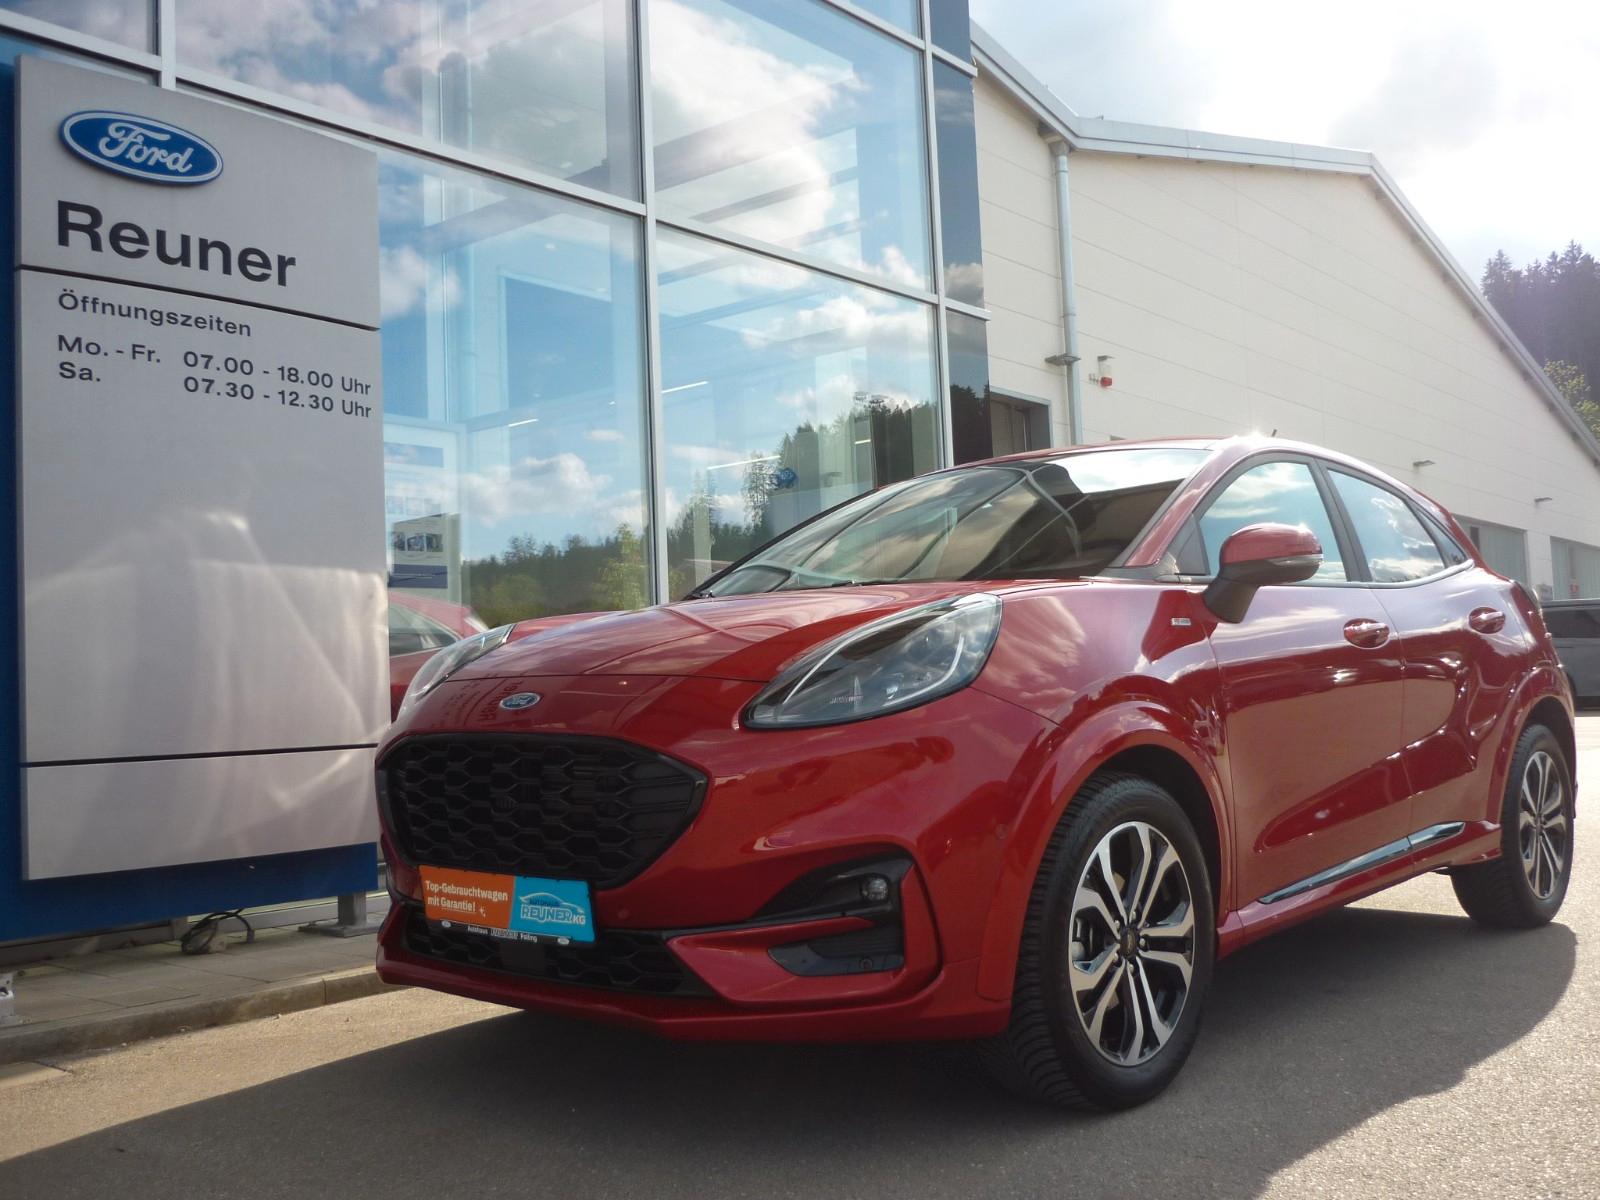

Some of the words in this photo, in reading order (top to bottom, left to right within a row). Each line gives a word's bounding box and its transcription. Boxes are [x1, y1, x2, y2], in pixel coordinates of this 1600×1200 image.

[98, 121, 193, 174] Ford
[57, 200, 296, 287] Reuner
[58, 288, 251, 337] Öffnungszeiten
[58, 334, 109, 357] Mo.
[131, 344, 161, 363] Fr.
[183, 351, 254, 376] 07.00
[277, 365, 334, 389] 18.00
[341, 376, 371, 396] Uhr
[58, 362, 101, 382] Sa.
[183, 376, 254, 400] 07.30
[277, 390, 334, 413] 12.30
[341, 399, 372, 419] Uhr
[426, 880, 509, 902] Top-Gebrauchtwagen
[427, 896, 440, 907] mit
[441, 897, 476, 912] Garantie!
[521, 904, 572, 923] REUNER
[573, 914, 586, 925] KG
